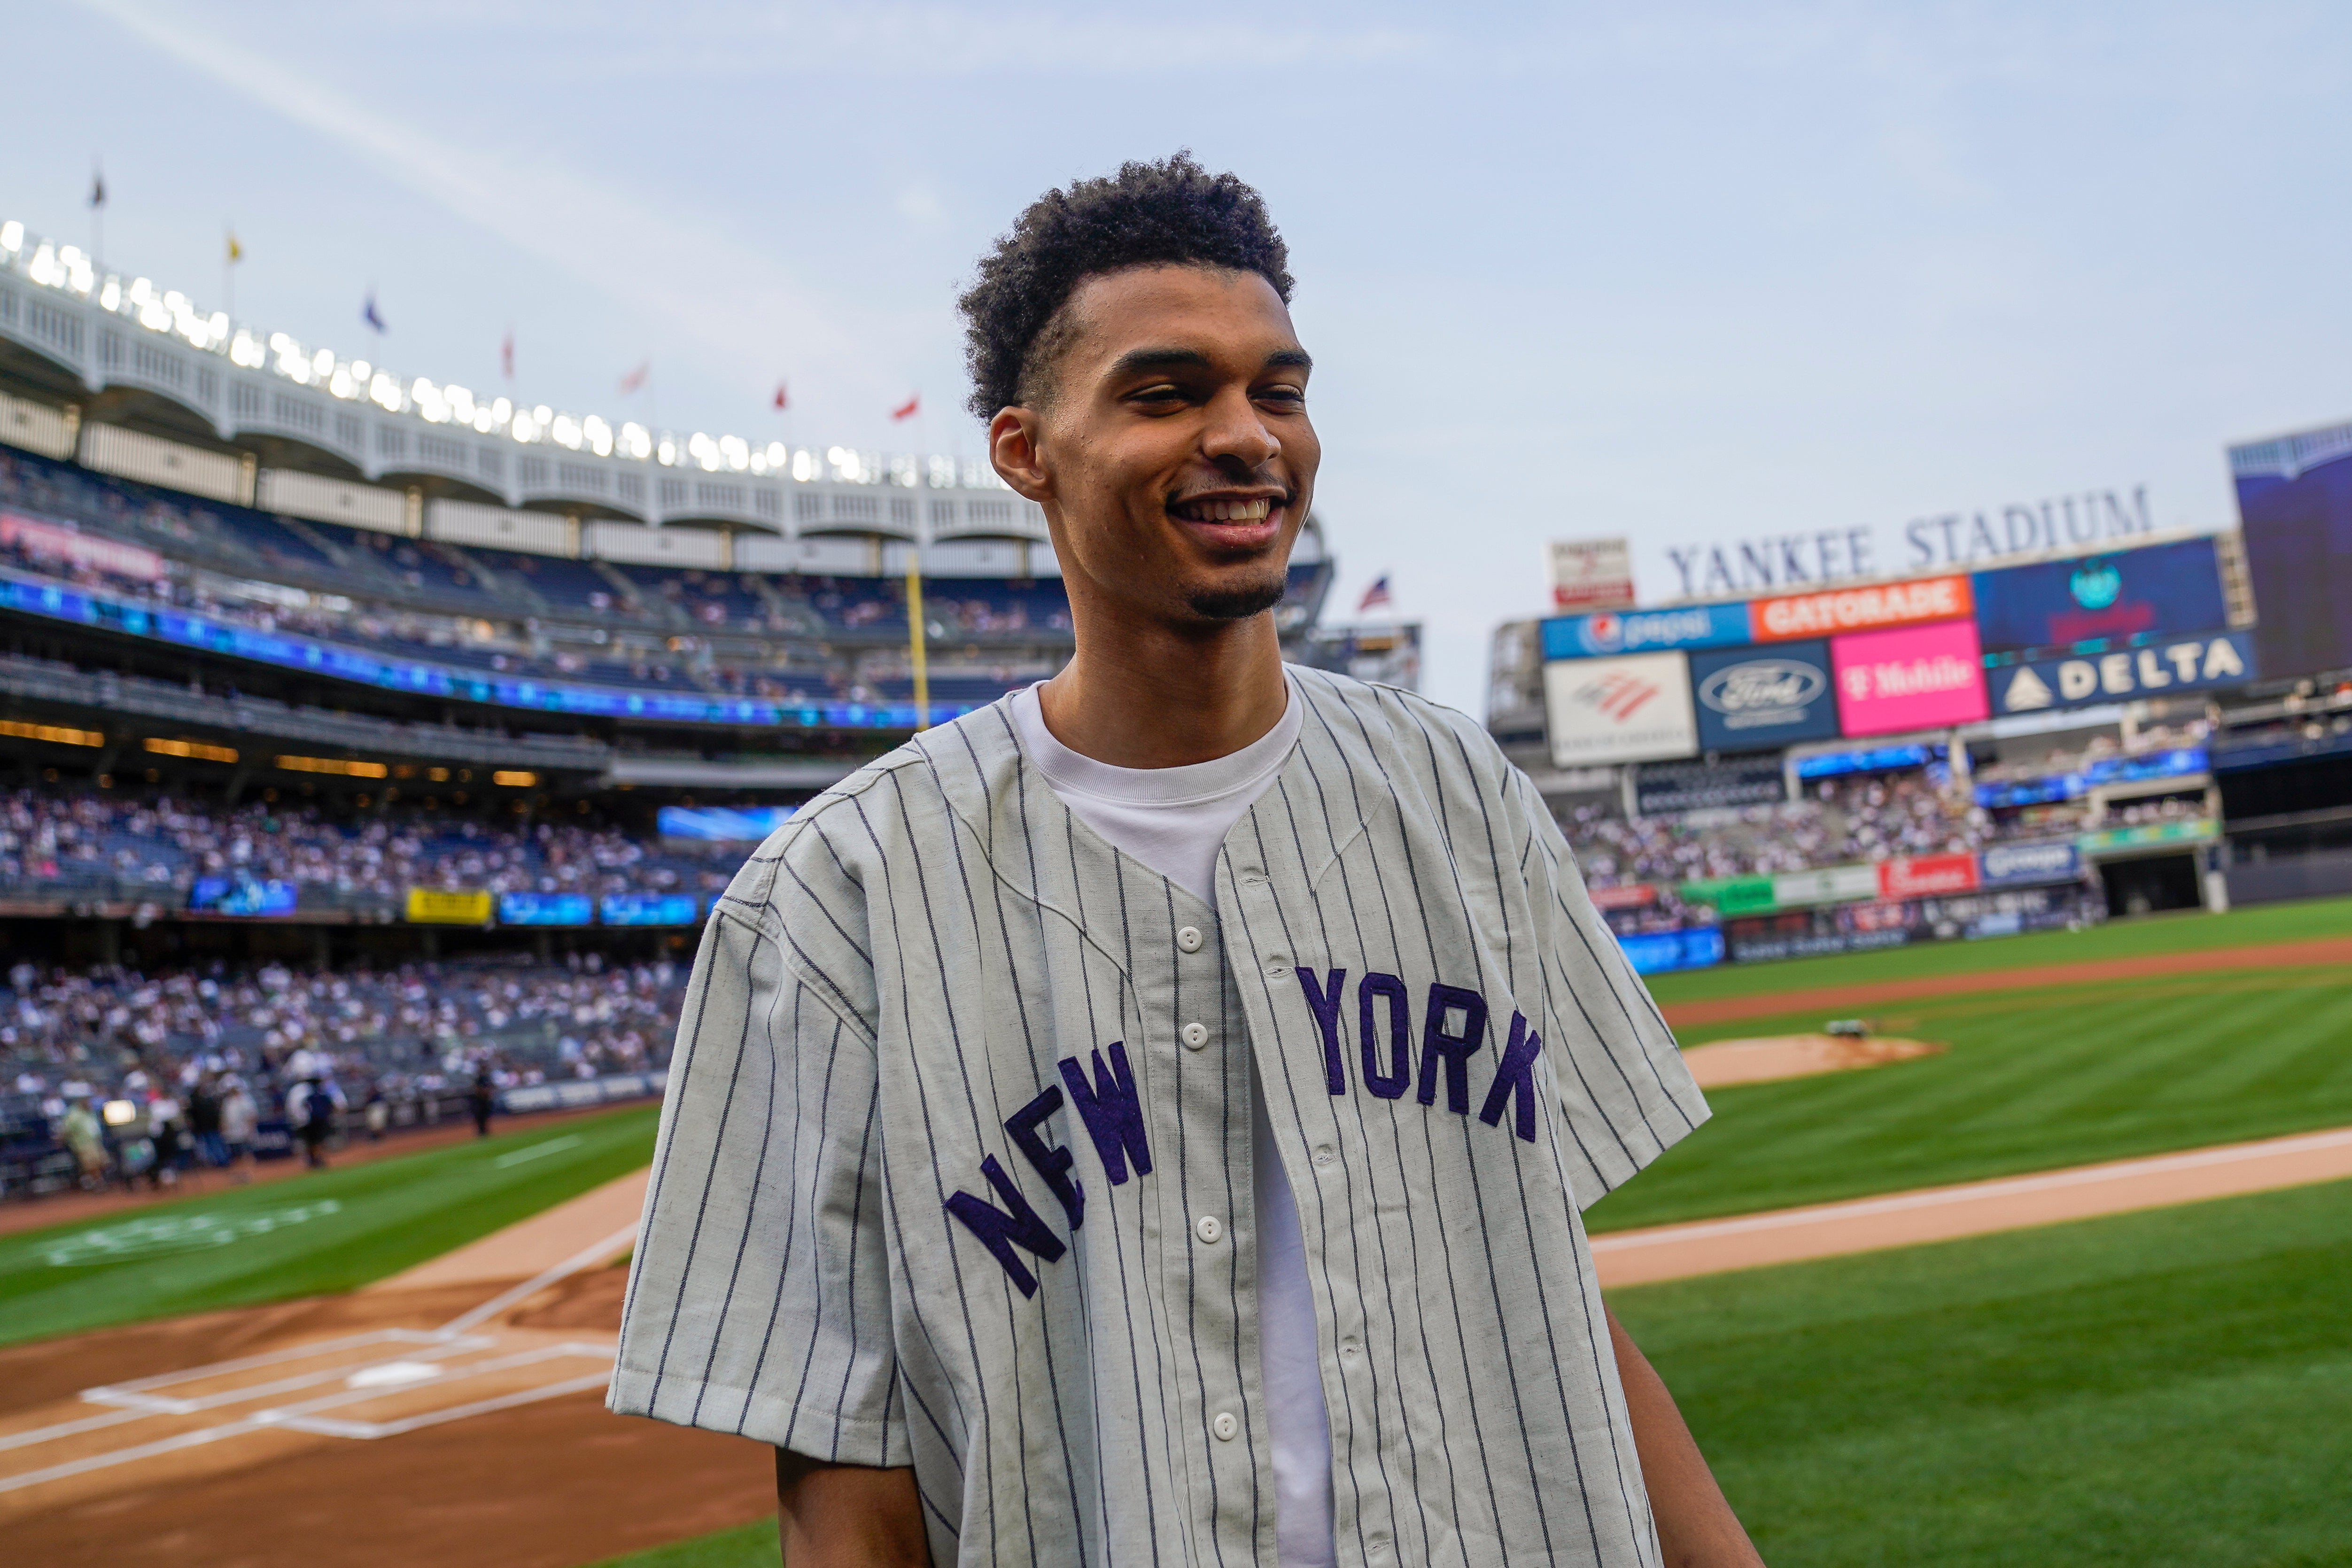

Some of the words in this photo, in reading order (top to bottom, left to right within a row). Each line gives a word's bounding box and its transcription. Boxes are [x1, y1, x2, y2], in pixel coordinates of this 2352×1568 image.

[1665, 523, 1874, 596] YANKEE
[1904, 482, 2155, 567] STADIUM
[1764, 578, 1958, 635] GATORADE
[1721, 666, 1804, 711] Ford
[2057, 637, 2244, 700] DELTA
[945, 1040, 1152, 1300] NEW
[1295, 967, 1542, 1143] YORK
